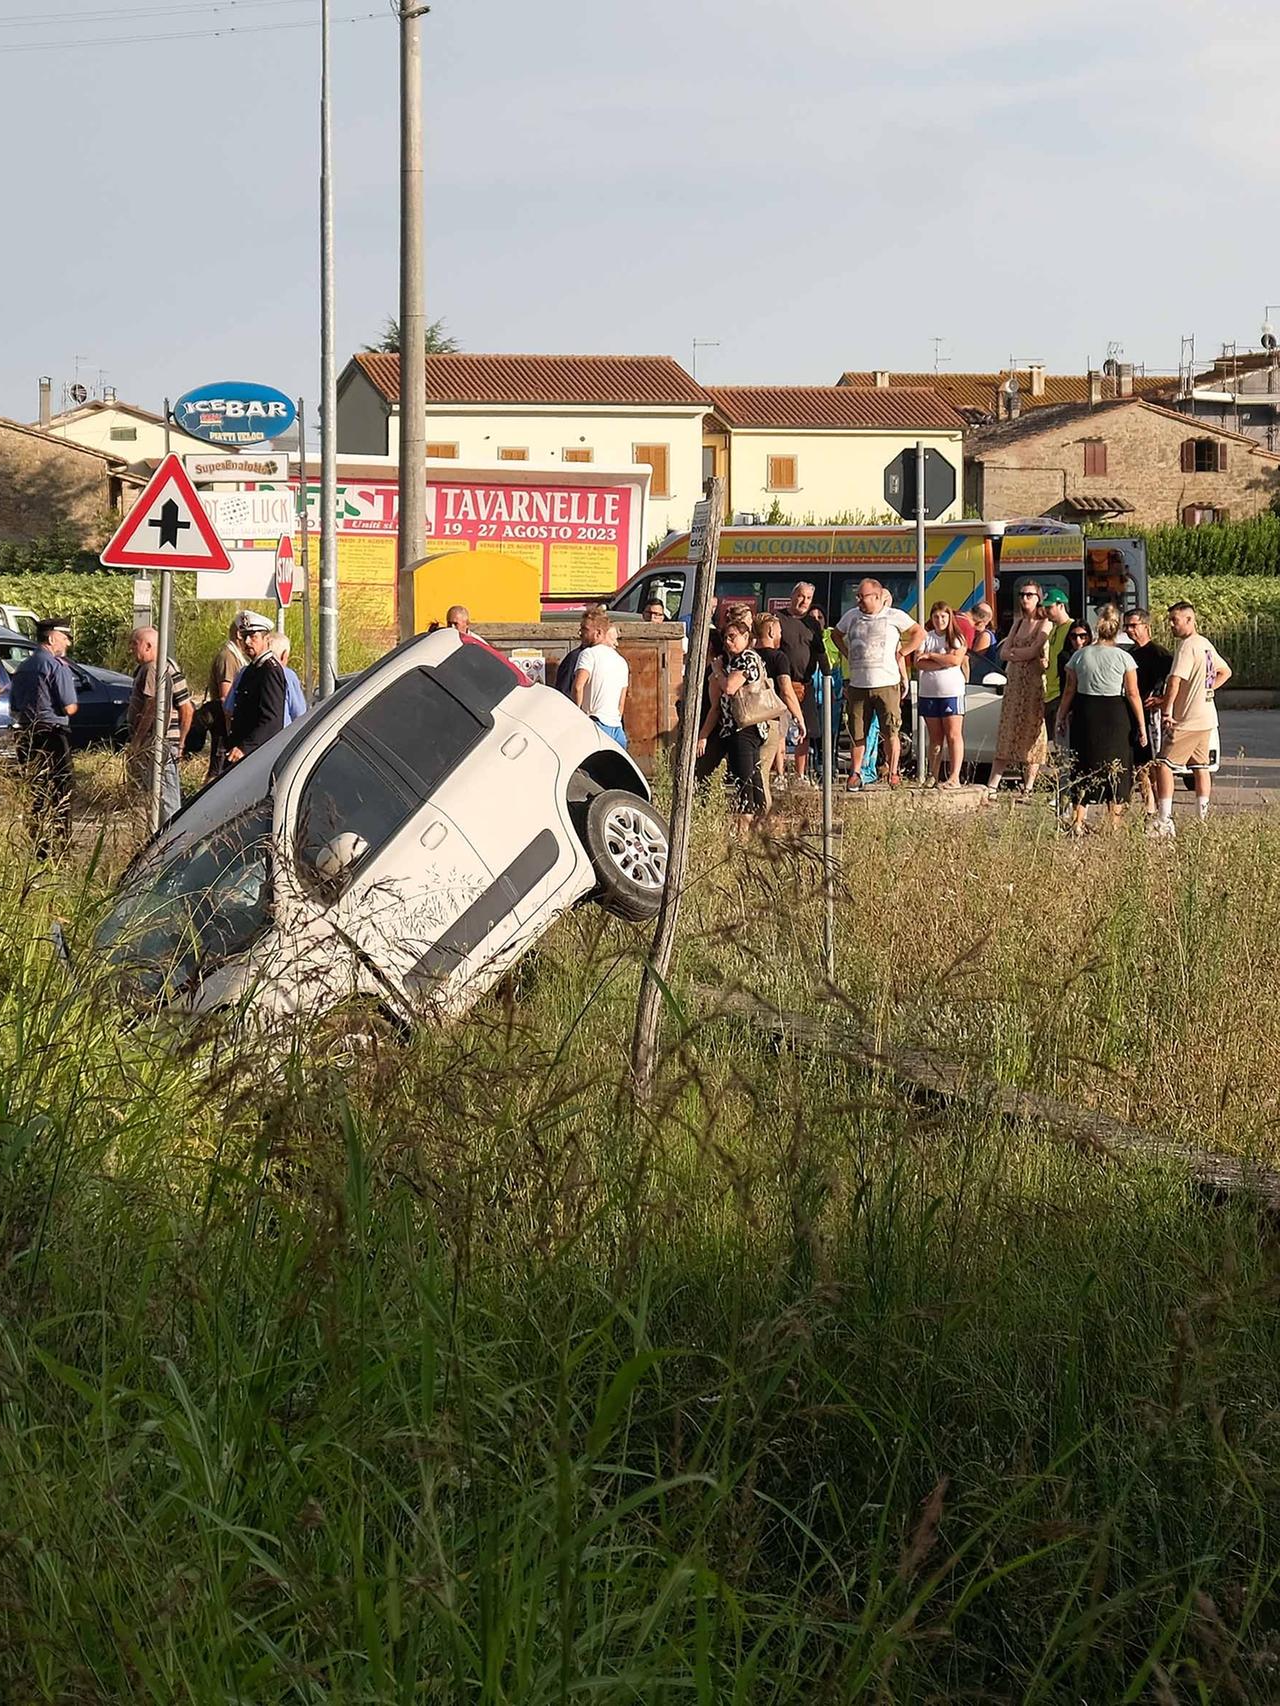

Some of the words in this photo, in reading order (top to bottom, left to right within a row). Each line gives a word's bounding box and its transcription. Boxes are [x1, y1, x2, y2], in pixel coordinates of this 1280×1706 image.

[195, 459, 269, 475] SuperEnalotto
[252, 499, 289, 523] LUCK
[441, 488, 620, 526] TAVARNELLE
[351, 520, 381, 529] Uniti
[382, 520, 393, 529] si
[443, 522, 463, 536] 19
[477, 524, 498, 537] 27
[502, 525, 573, 539] AGOSTO
[577, 527, 617, 541] 2023
[734, 538, 827, 555] SOCCORSO
[277, 557, 293, 583] STOP
